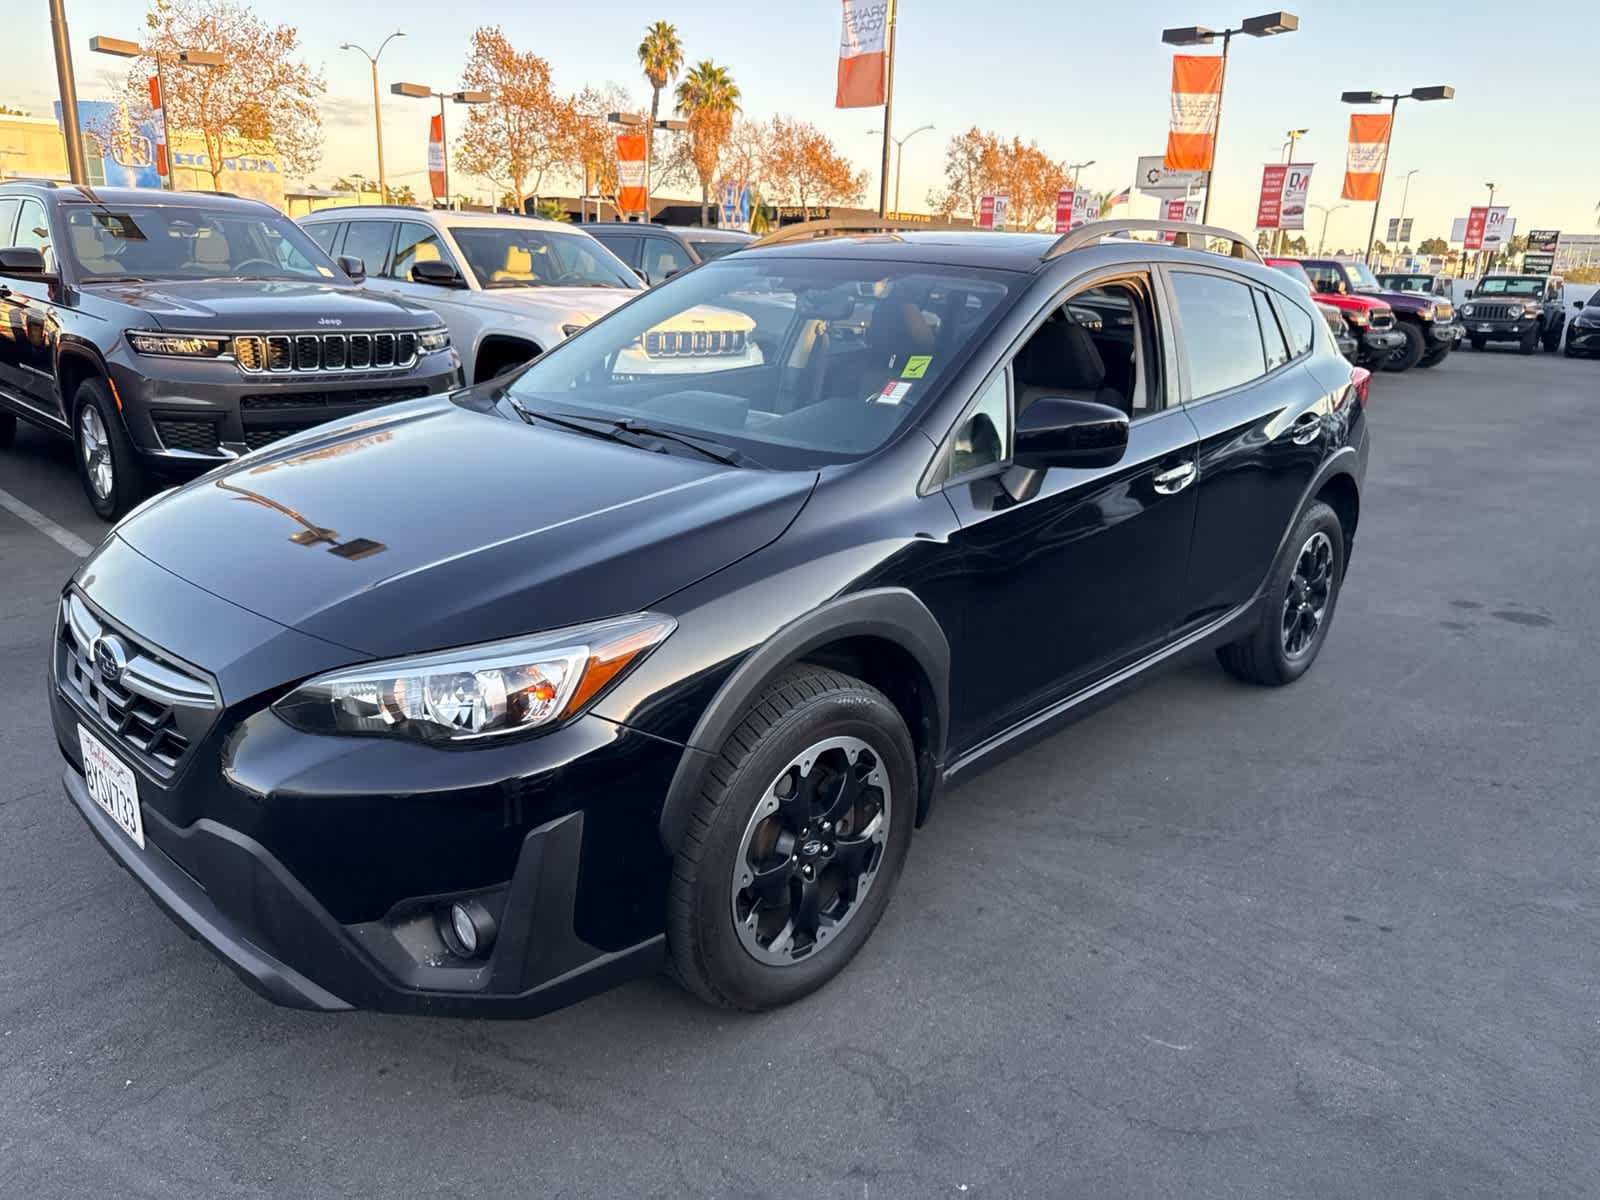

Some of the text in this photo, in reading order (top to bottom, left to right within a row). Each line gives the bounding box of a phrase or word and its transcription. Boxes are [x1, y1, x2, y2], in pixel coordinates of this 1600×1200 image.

[175, 153, 277, 173] HONDA
[318, 317, 342, 326] Jeep
[84, 757, 137, 834] 8YSV733
